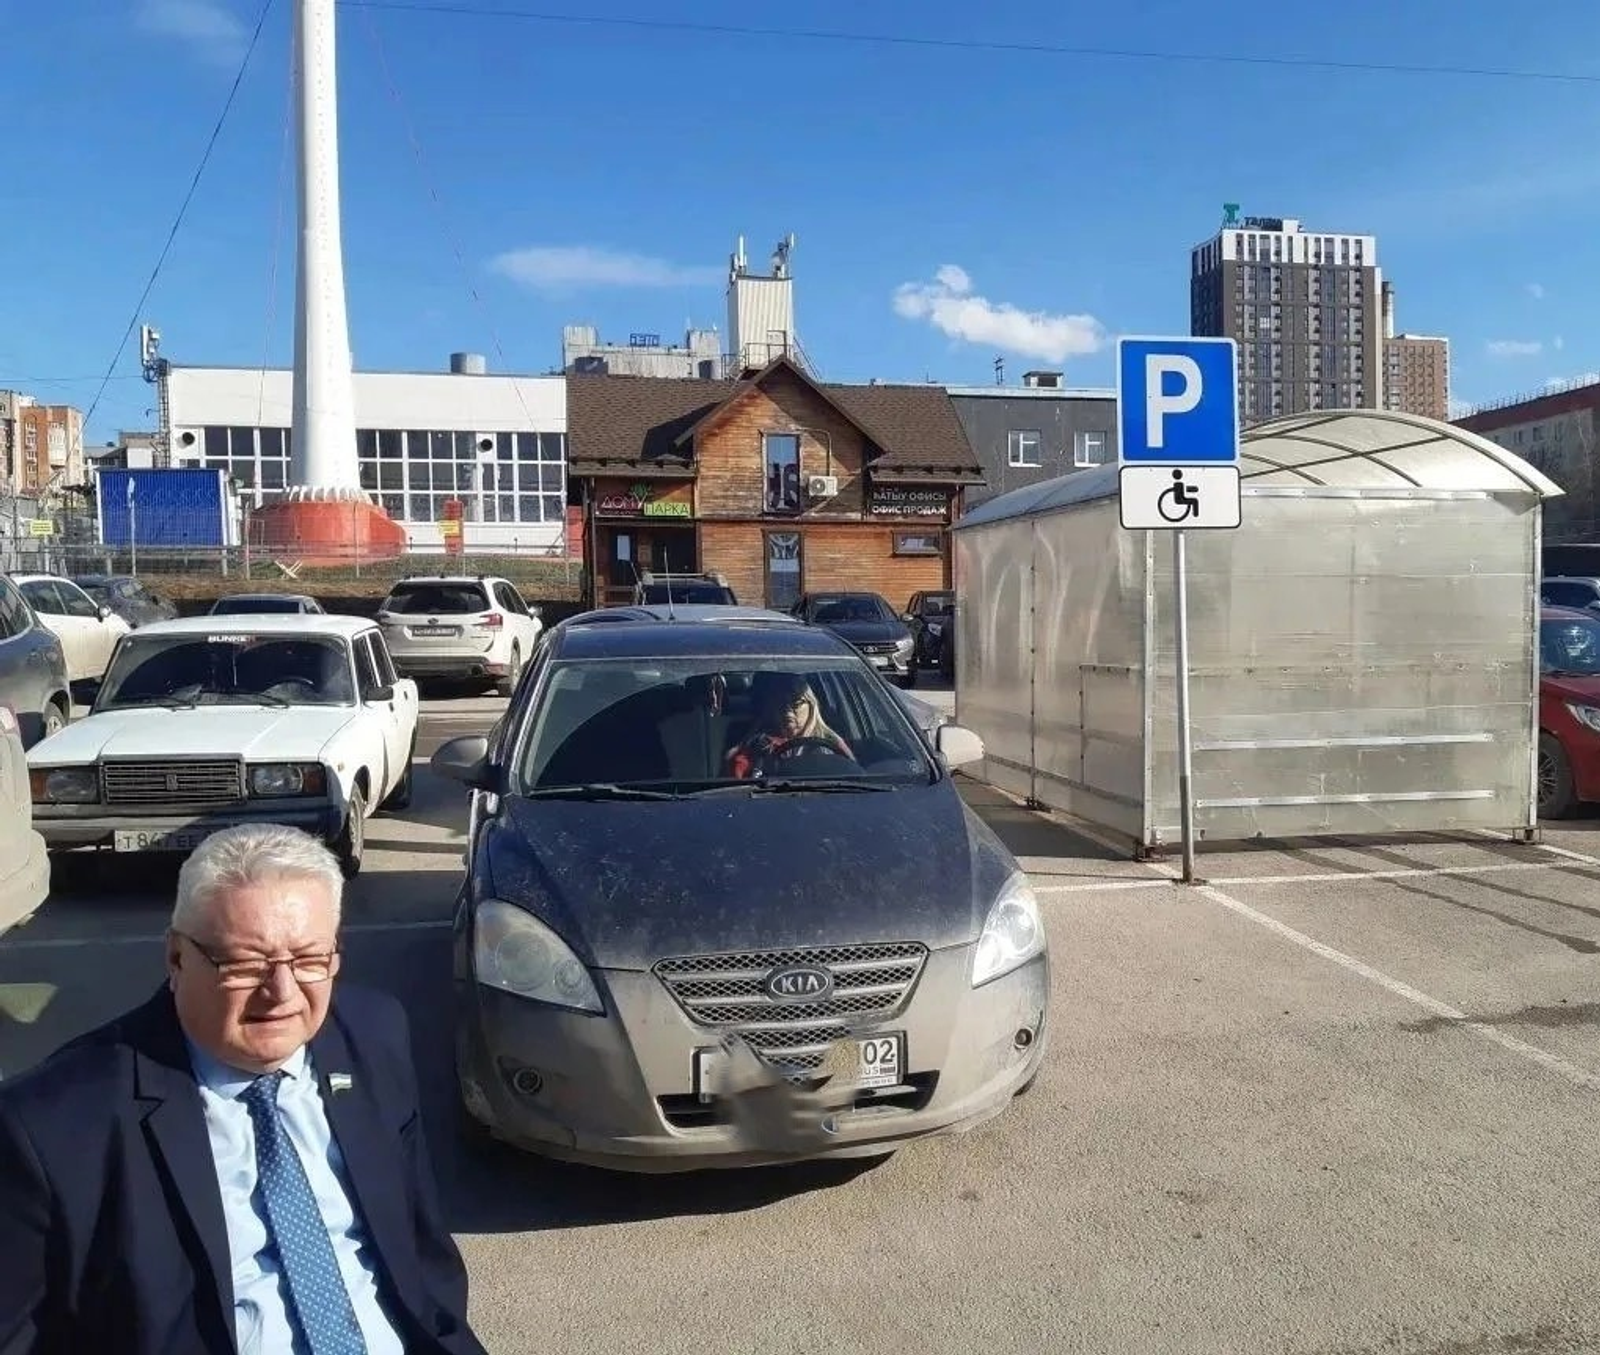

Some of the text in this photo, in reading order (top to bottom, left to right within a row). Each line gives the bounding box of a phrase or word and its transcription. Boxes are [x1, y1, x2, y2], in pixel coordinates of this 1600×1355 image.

[1146, 354, 1203, 448] P
[909, 491, 947, 501] ОФИСЫ
[644, 503, 691, 516] ПАРКА
[872, 505, 947, 515] ОФИС ПРОДАЖ
[781, 974, 820, 993] KIA
[863, 1039, 894, 1065] 02
